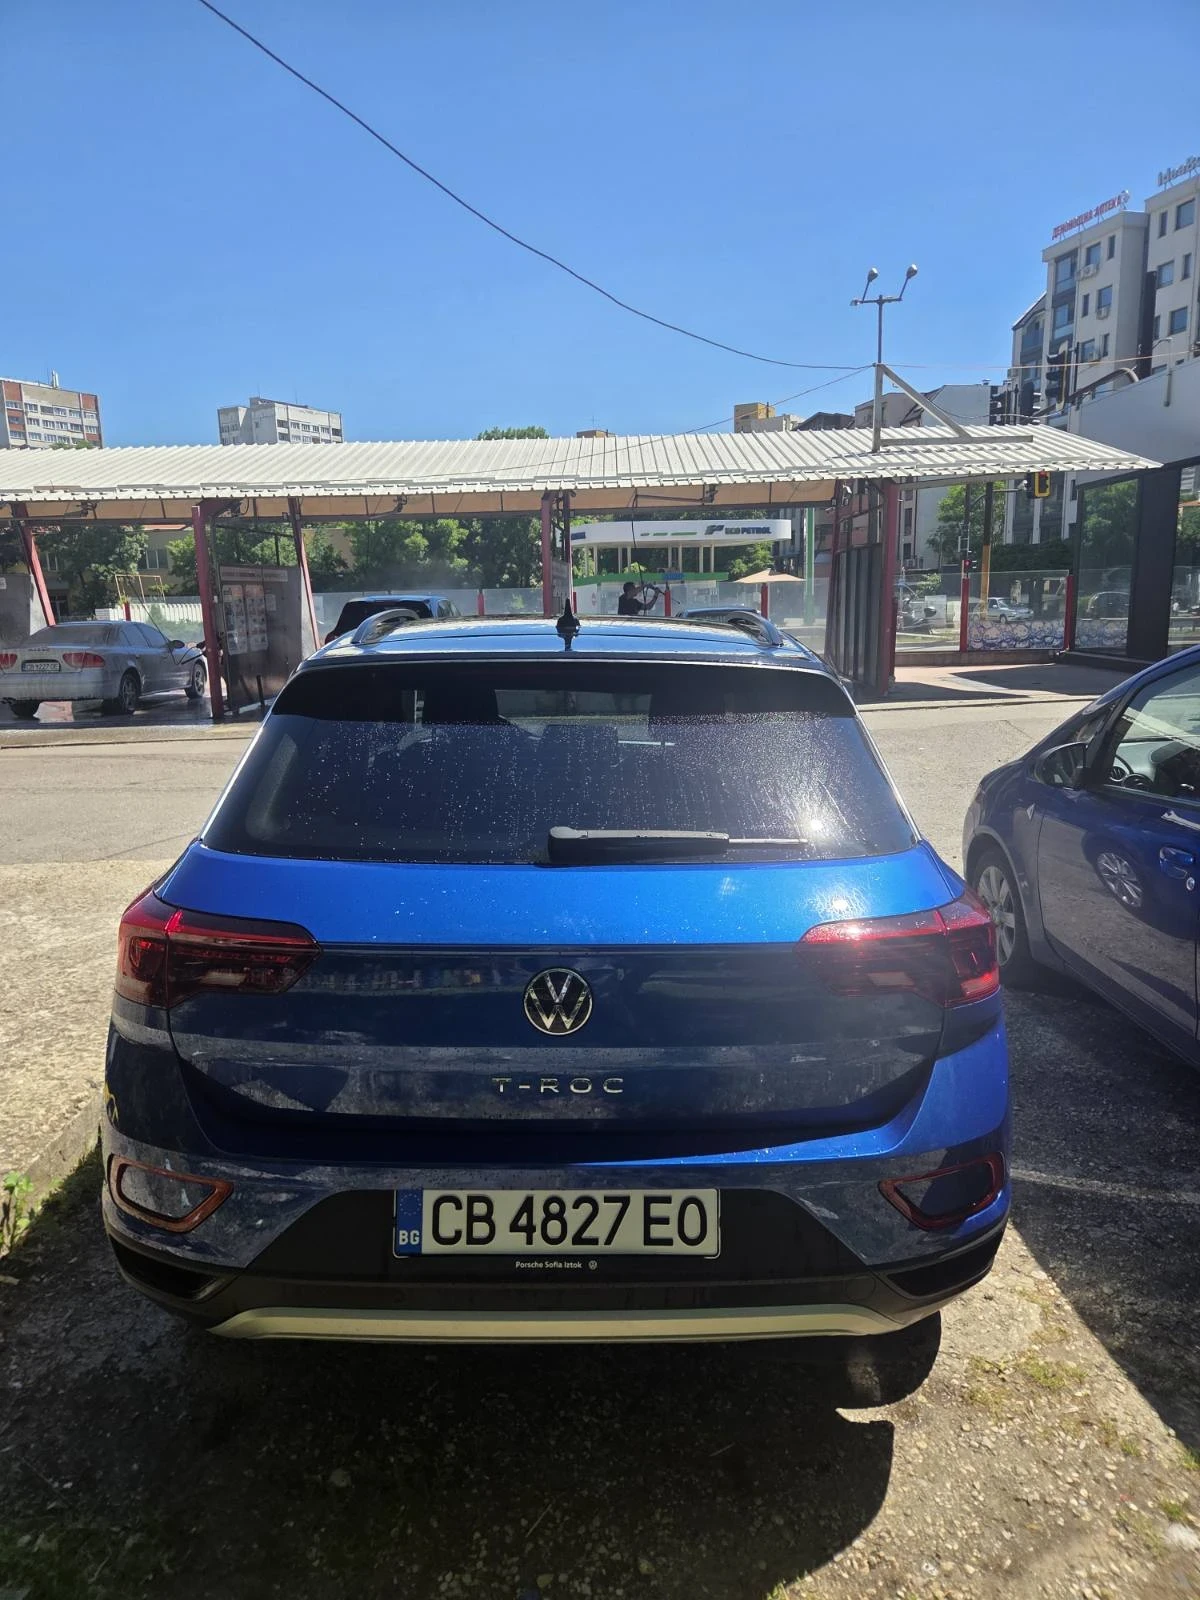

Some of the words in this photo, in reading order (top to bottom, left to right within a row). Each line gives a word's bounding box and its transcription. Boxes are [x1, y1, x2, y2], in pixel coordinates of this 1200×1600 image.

[741, 526, 772, 534] PETROL
[492, 1077, 624, 1093] T-ROC
[431, 1194, 496, 1246] CB
[509, 1194, 631, 1246] 4827
[643, 1194, 708, 1247] EO
[398, 1229, 420, 1245] BG
